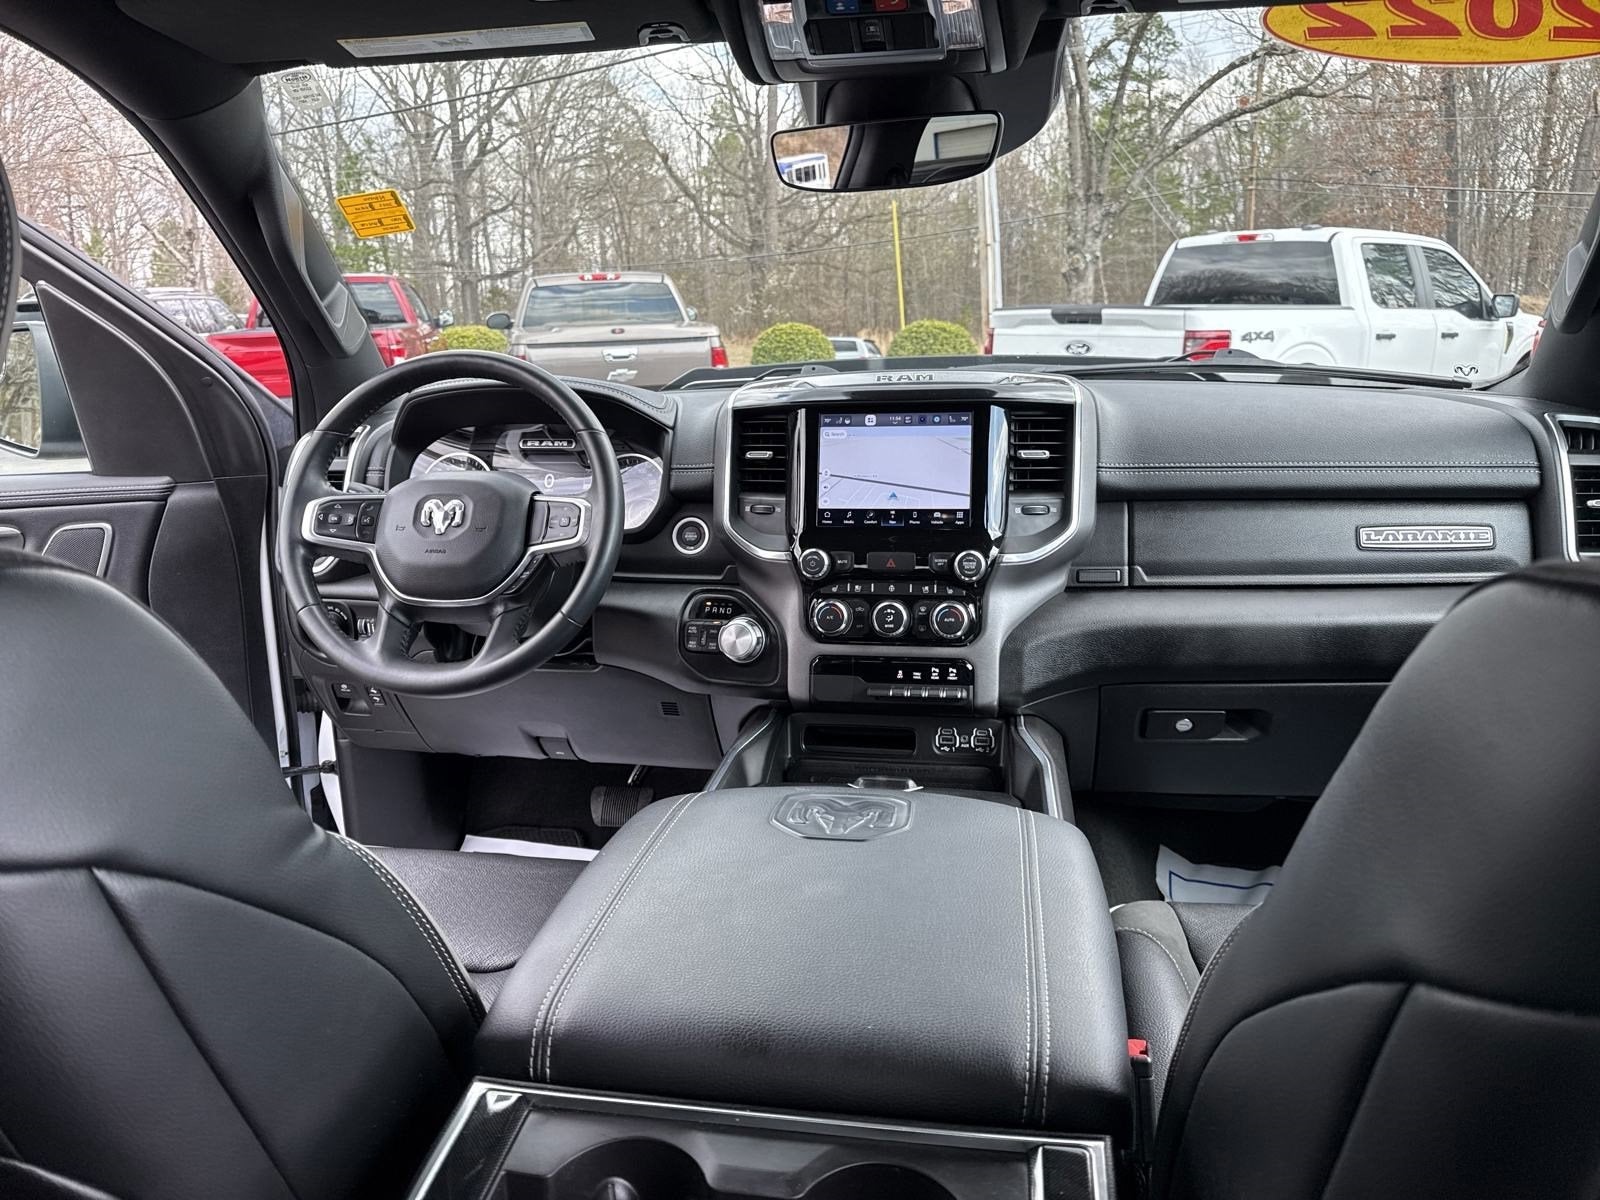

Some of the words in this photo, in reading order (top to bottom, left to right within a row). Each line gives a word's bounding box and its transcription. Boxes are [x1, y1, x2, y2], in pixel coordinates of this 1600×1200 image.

[876, 374, 934, 382] RAM
[526, 439, 569, 447] RAM
[544, 474, 555, 488] 0
[1362, 529, 1491, 545] LARAMIE
